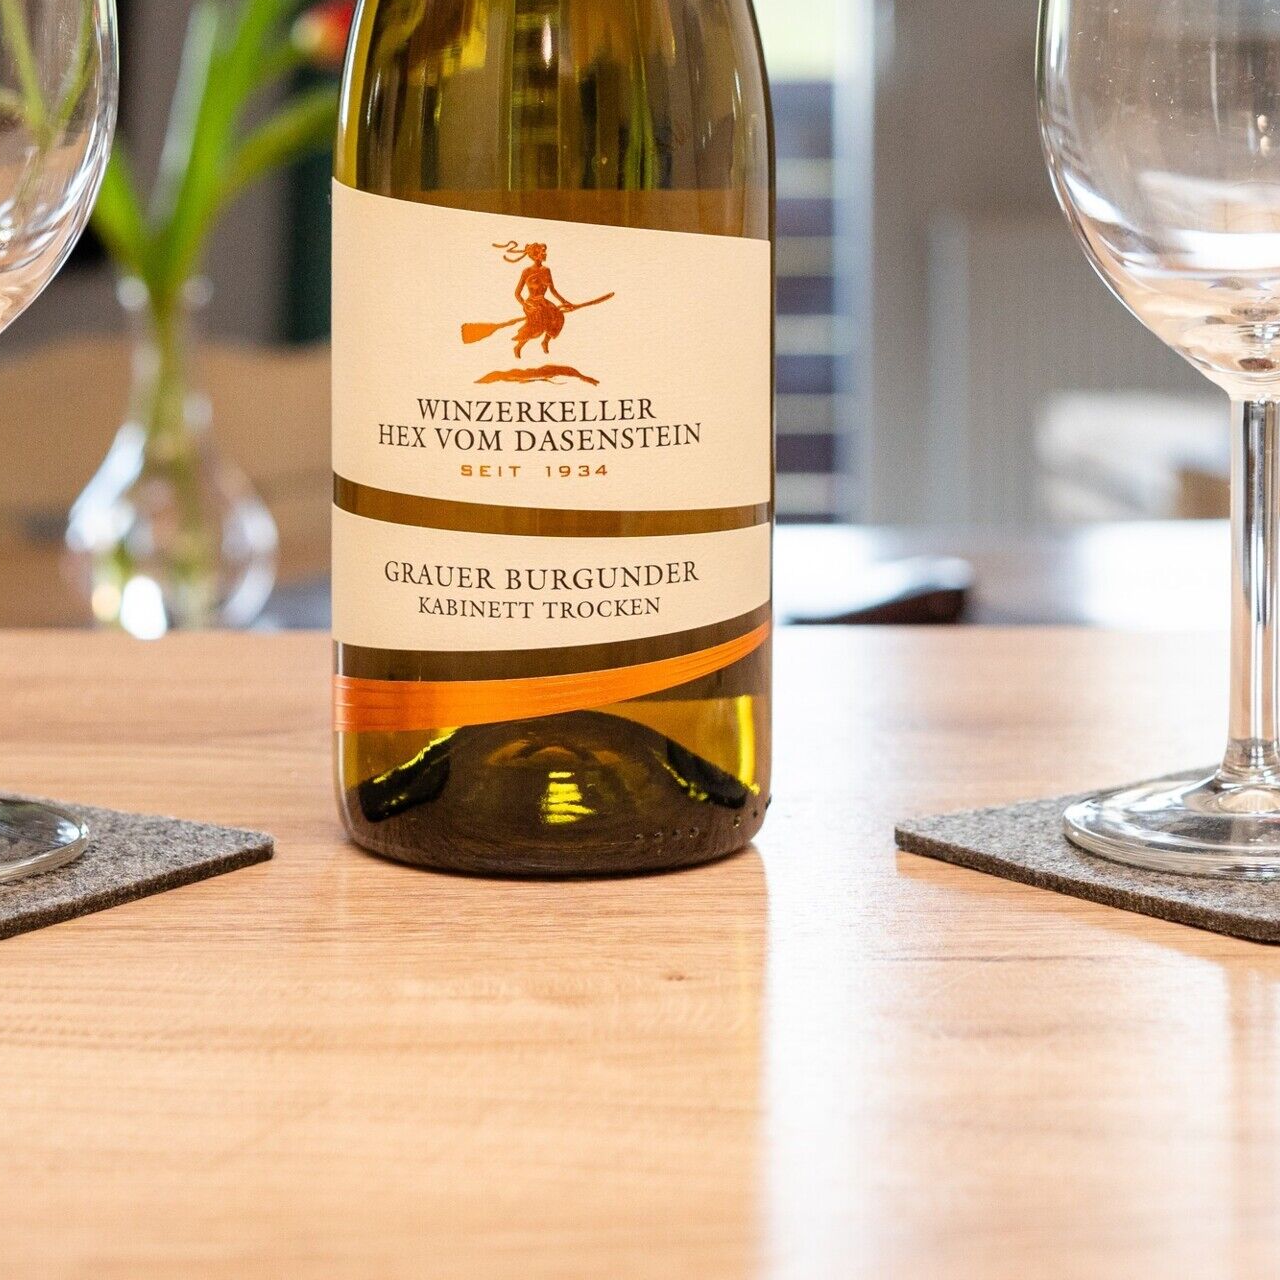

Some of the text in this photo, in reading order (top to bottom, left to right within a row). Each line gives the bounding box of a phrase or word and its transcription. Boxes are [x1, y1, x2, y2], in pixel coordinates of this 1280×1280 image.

[416, 397, 657, 423] WINZERKELLER
[378, 422, 702, 452] HEX VOM DASENSTEIN
[460, 464, 609, 478] SEIT 1934
[384, 560, 700, 591] GRAUER BURGUNDER
[418, 595, 661, 620] KABINETT TROCKEN
